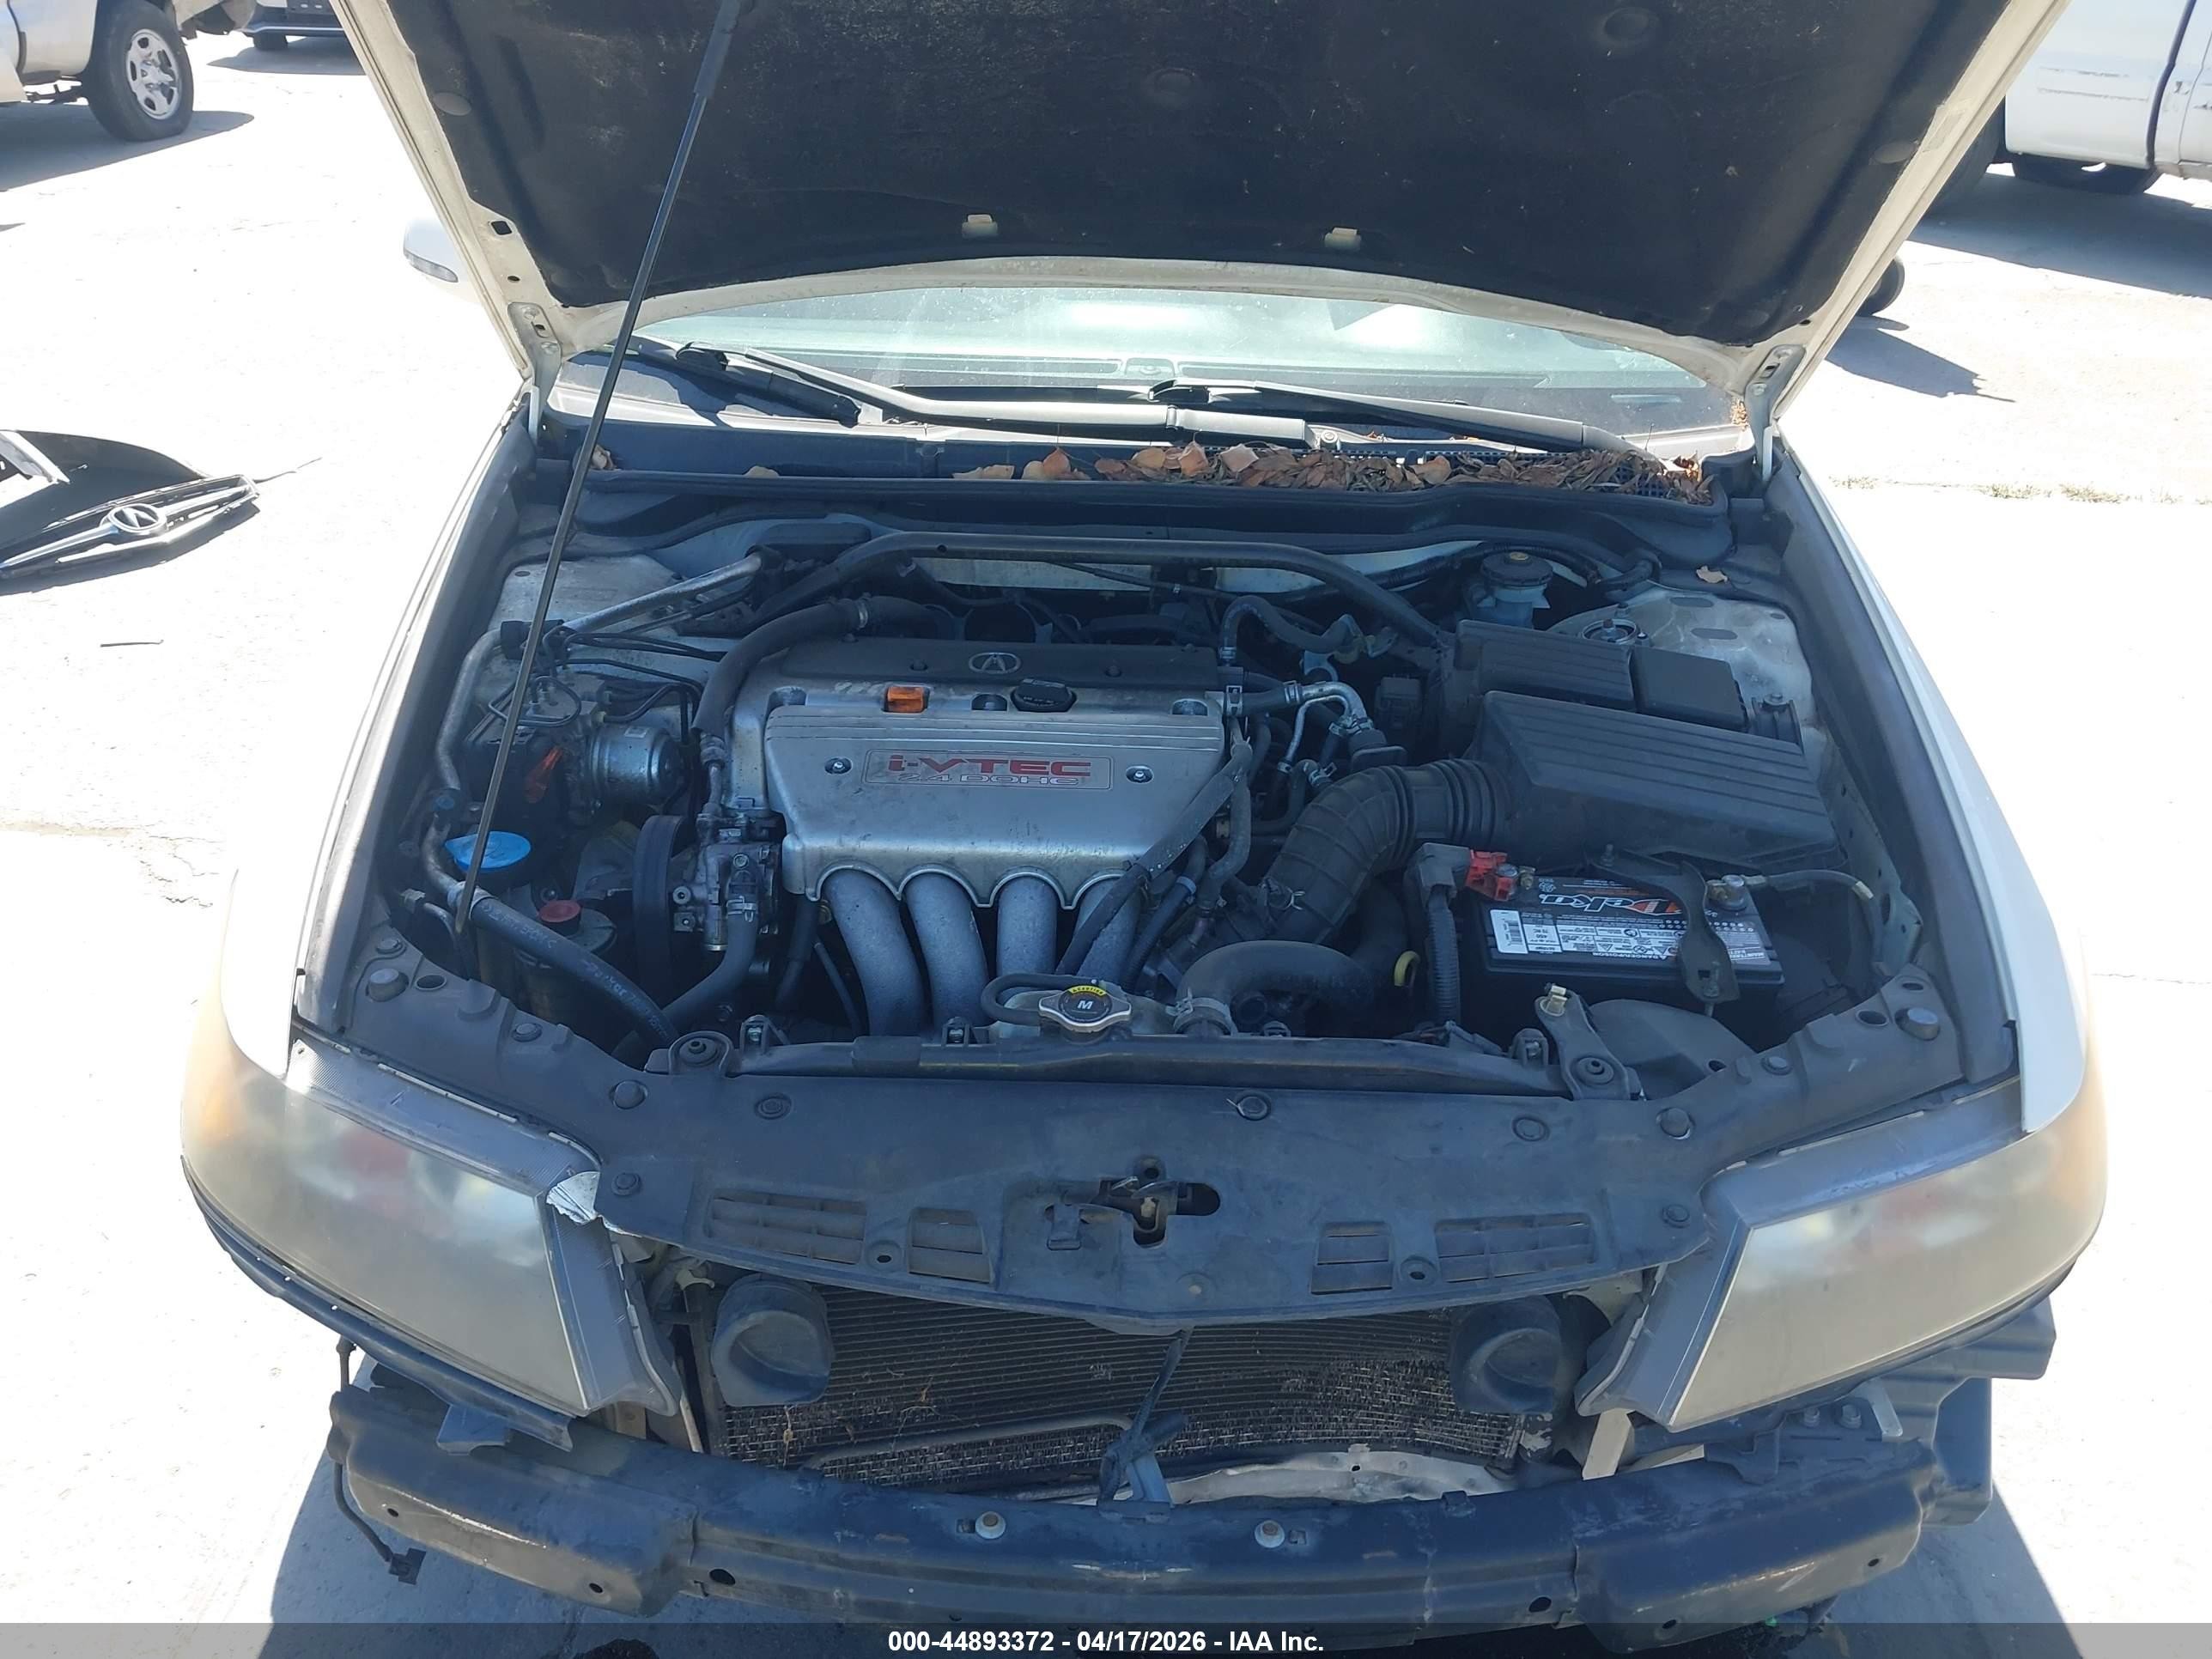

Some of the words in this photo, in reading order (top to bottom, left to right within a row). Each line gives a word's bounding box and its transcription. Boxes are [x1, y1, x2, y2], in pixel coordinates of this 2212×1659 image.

[887, 754, 1091, 777] i-VTEC
[899, 774, 952, 782] 2.4
[959, 774, 1079, 786] DOHC
[1539, 893, 1682, 916] Deka
[1077, 1000, 1094, 1010] M
